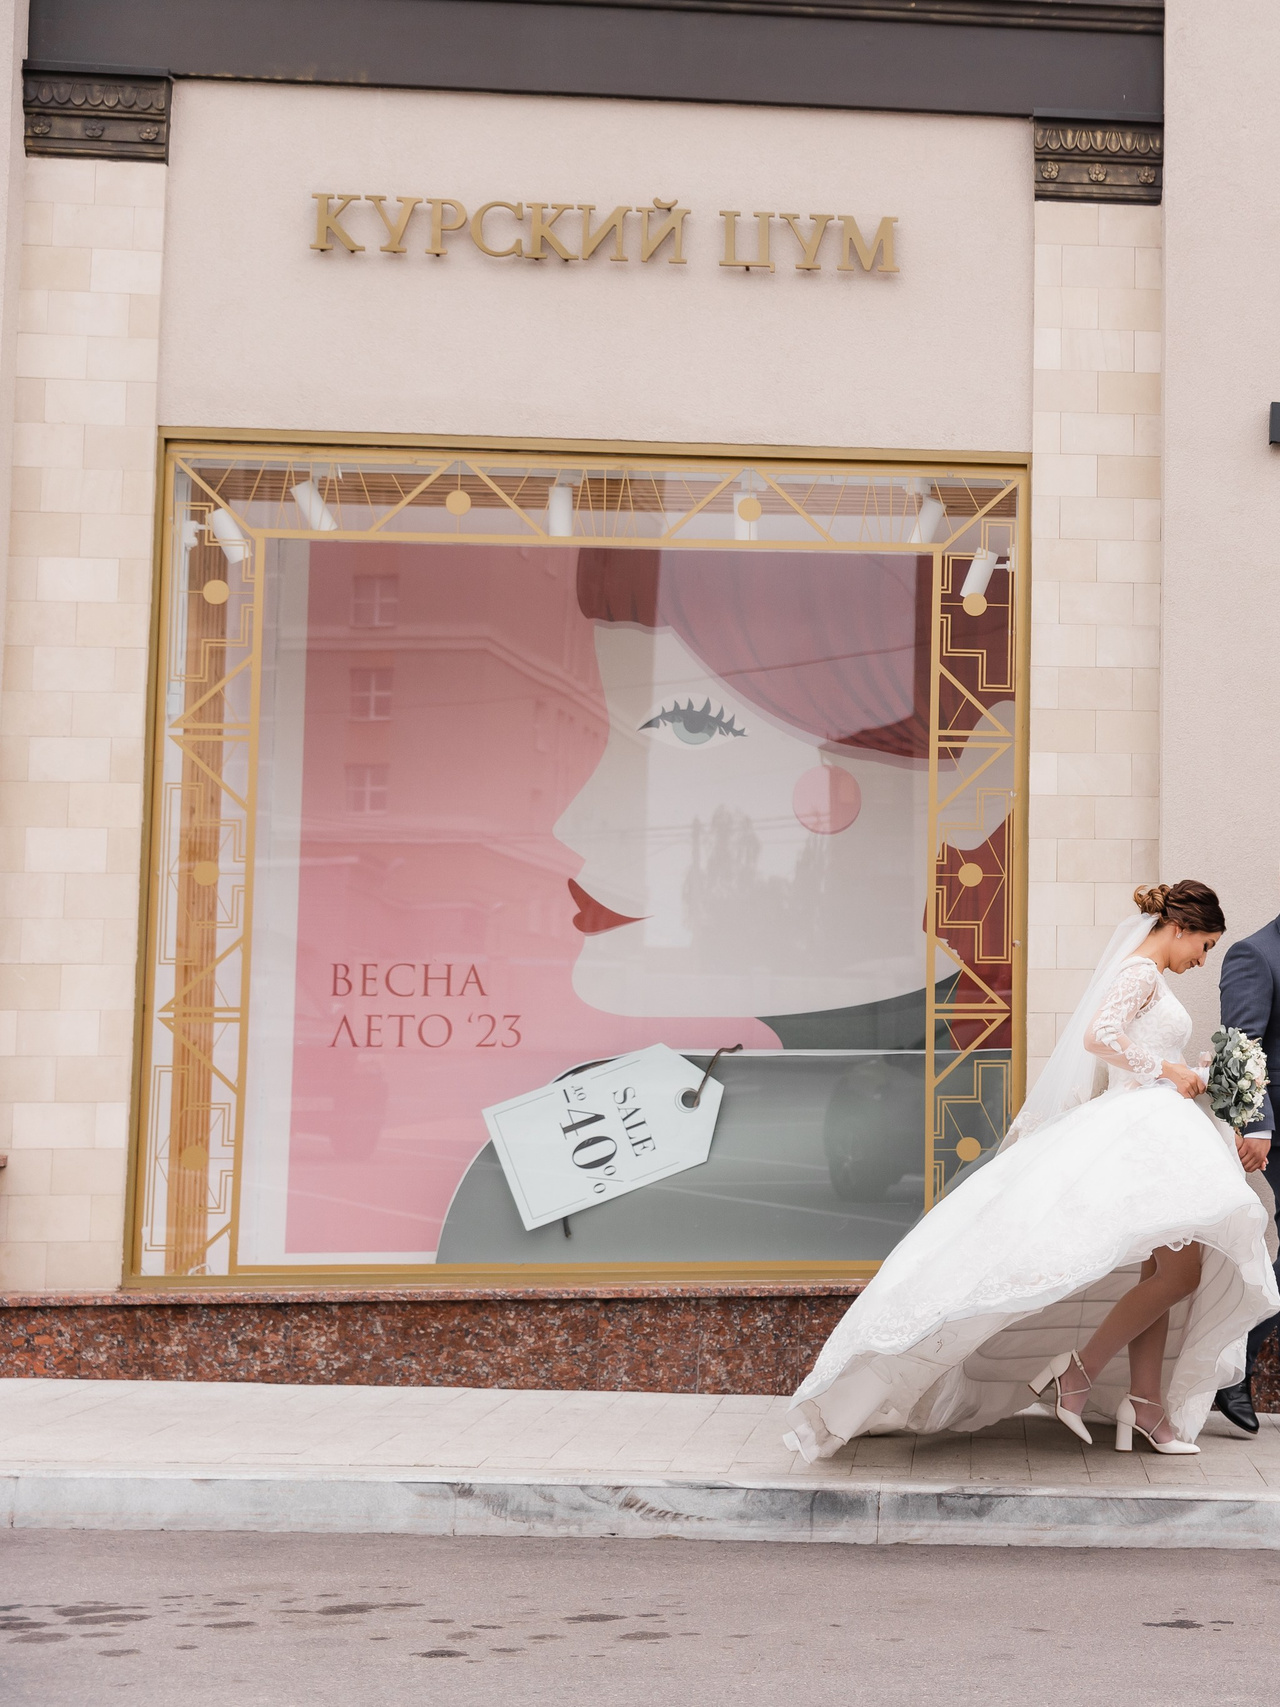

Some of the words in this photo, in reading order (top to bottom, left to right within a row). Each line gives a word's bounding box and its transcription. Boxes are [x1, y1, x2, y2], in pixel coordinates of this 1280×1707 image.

[309, 193, 692, 264] КУРСКИЙ
[719, 210, 900, 273] ЦУМ
[330, 963, 488, 997] ВЕСНА
[327, 1013, 453, 1048] ЛЕТО
[571, 1085, 587, 1101] до
[612, 1086, 656, 1157] SALE
